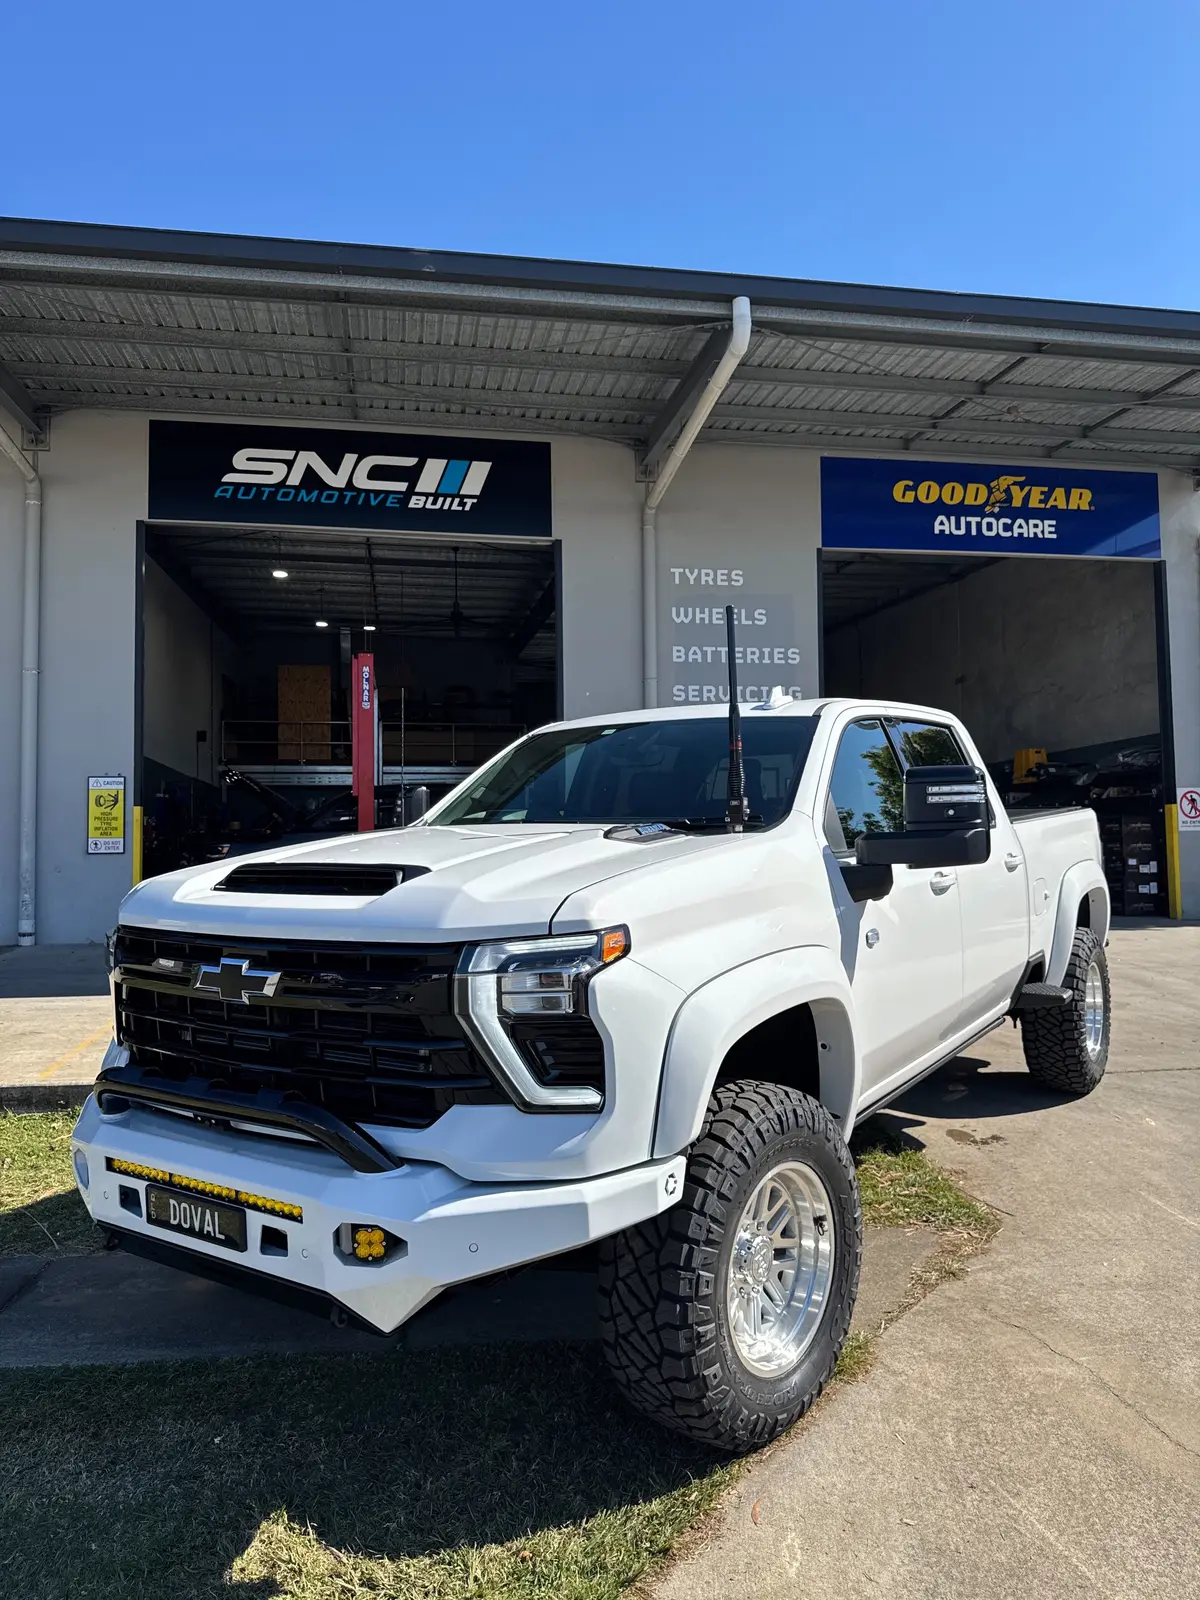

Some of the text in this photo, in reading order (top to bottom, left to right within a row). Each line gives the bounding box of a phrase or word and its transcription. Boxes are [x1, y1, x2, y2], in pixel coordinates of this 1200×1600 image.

[221, 447, 419, 492] SNC
[214, 485, 403, 507] AUTOMOTIVE
[408, 495, 477, 511] BUILT
[893, 480, 1093, 511] GOODYEAR
[934, 515, 1057, 539] AUTOCARE
[670, 568, 744, 586] TYRES
[672, 646, 800, 664] BATTERIES
[362, 665, 370, 702] MOLNAR
[672, 685, 802, 702] SERVICIG
[169, 1198, 226, 1240] DOVAL
